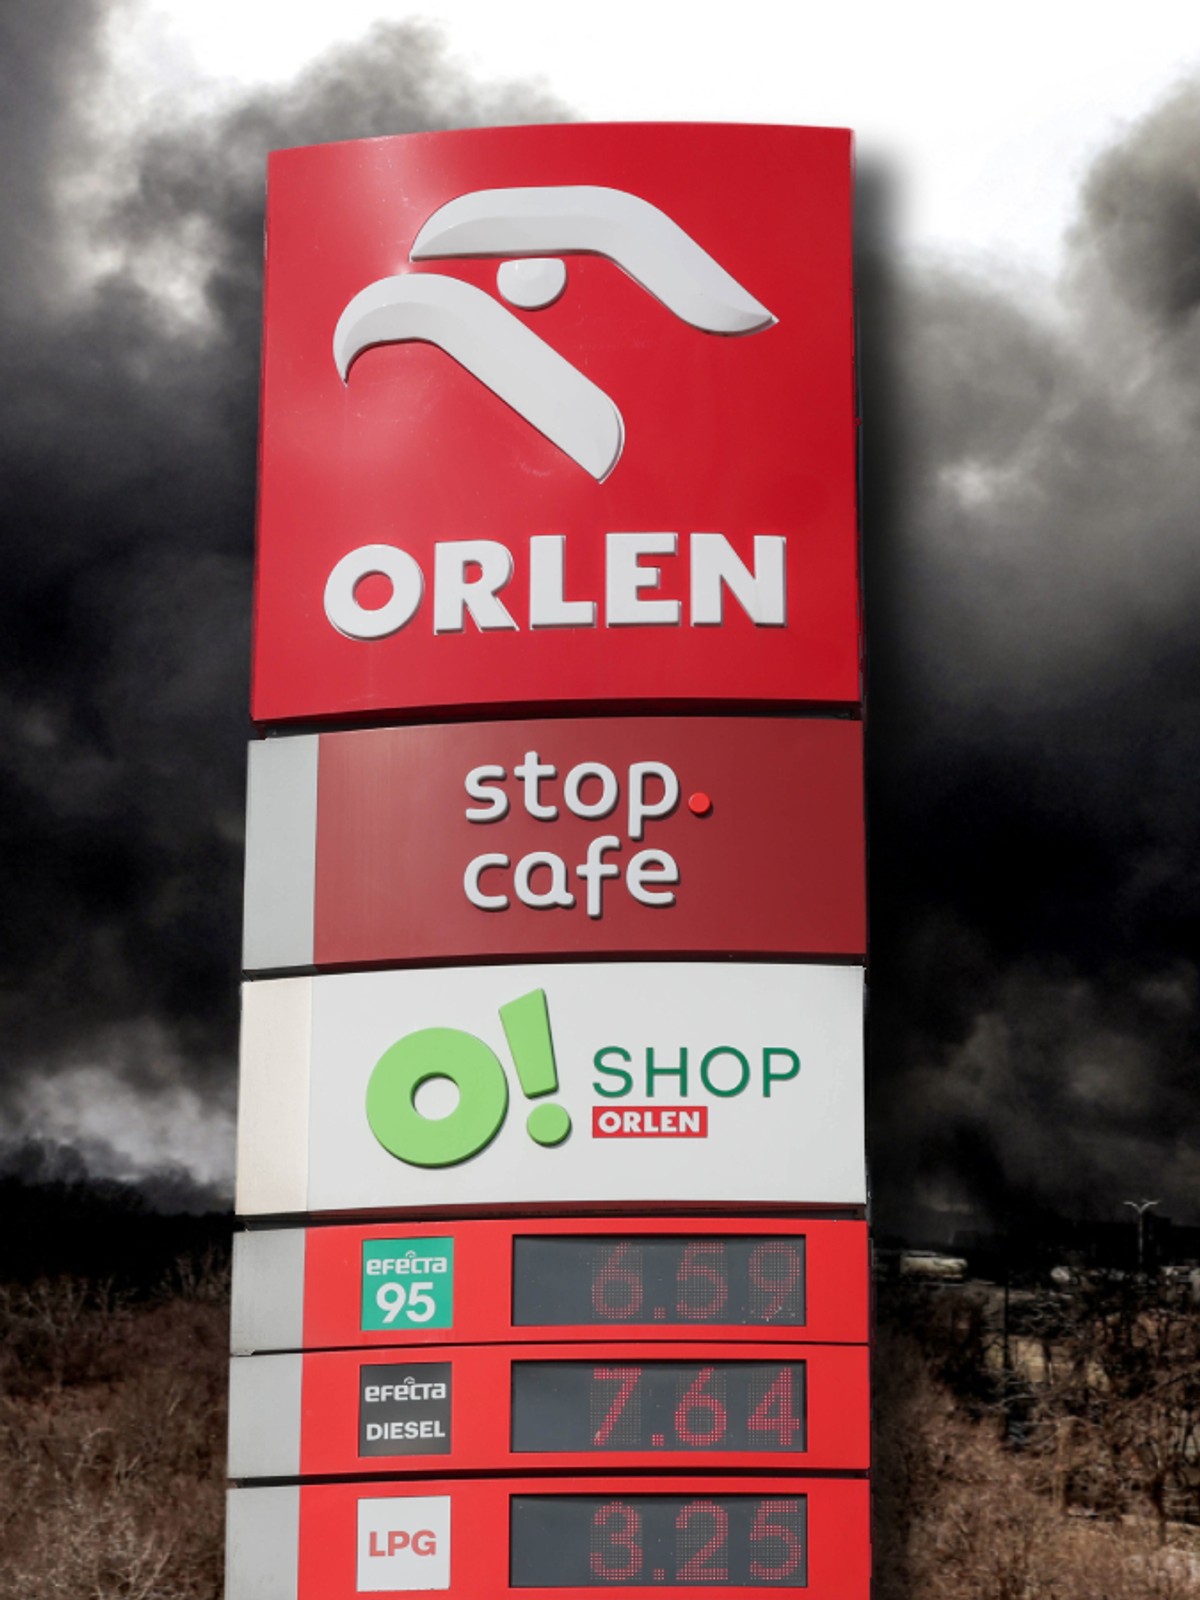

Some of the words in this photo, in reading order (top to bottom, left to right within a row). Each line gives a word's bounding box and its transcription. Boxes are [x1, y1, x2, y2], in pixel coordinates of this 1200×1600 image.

[323, 532, 788, 641] ORLEN
[463, 835, 680, 919] cafe
[592, 1045, 802, 1098] SHOP
[598, 1110, 701, 1134] ORLEN
[375, 1281, 436, 1323] 95
[590, 1242, 801, 1320] 6.59
[365, 1421, 446, 1441] DIESEL
[592, 1367, 800, 1446] 7.64
[367, 1530, 437, 1557] LPG
[589, 1501, 802, 1581] 3.25
